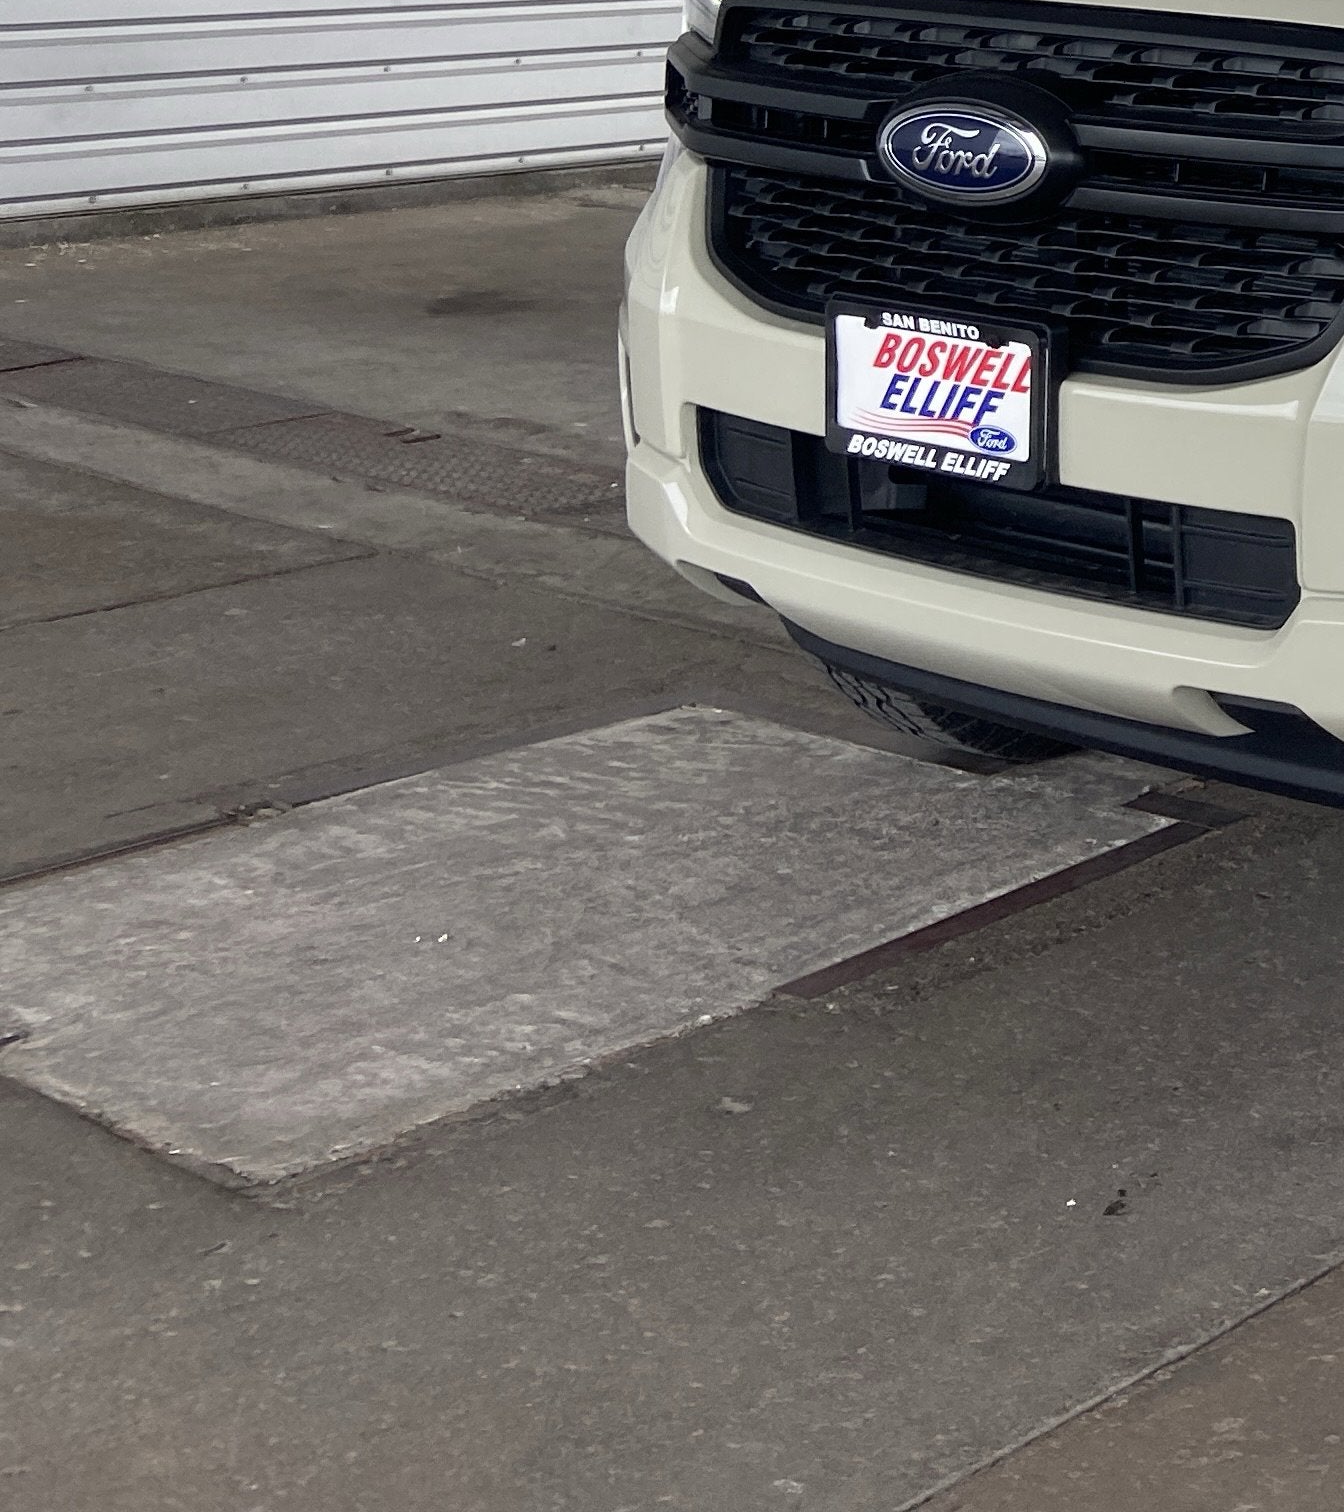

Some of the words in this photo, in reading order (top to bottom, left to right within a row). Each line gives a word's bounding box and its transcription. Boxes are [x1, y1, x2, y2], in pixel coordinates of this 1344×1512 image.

[912, 122, 1001, 179] Ford
[882, 312, 915, 331] SAN
[918, 317, 980, 340] BENITO
[873, 333, 1032, 394] BOSWELL
[880, 373, 1005, 427] ELLIFF
[847, 434, 937, 470] BOSWELL
[941, 452, 1010, 482] ELLIFF
[977, 428, 1008, 451] Ford
